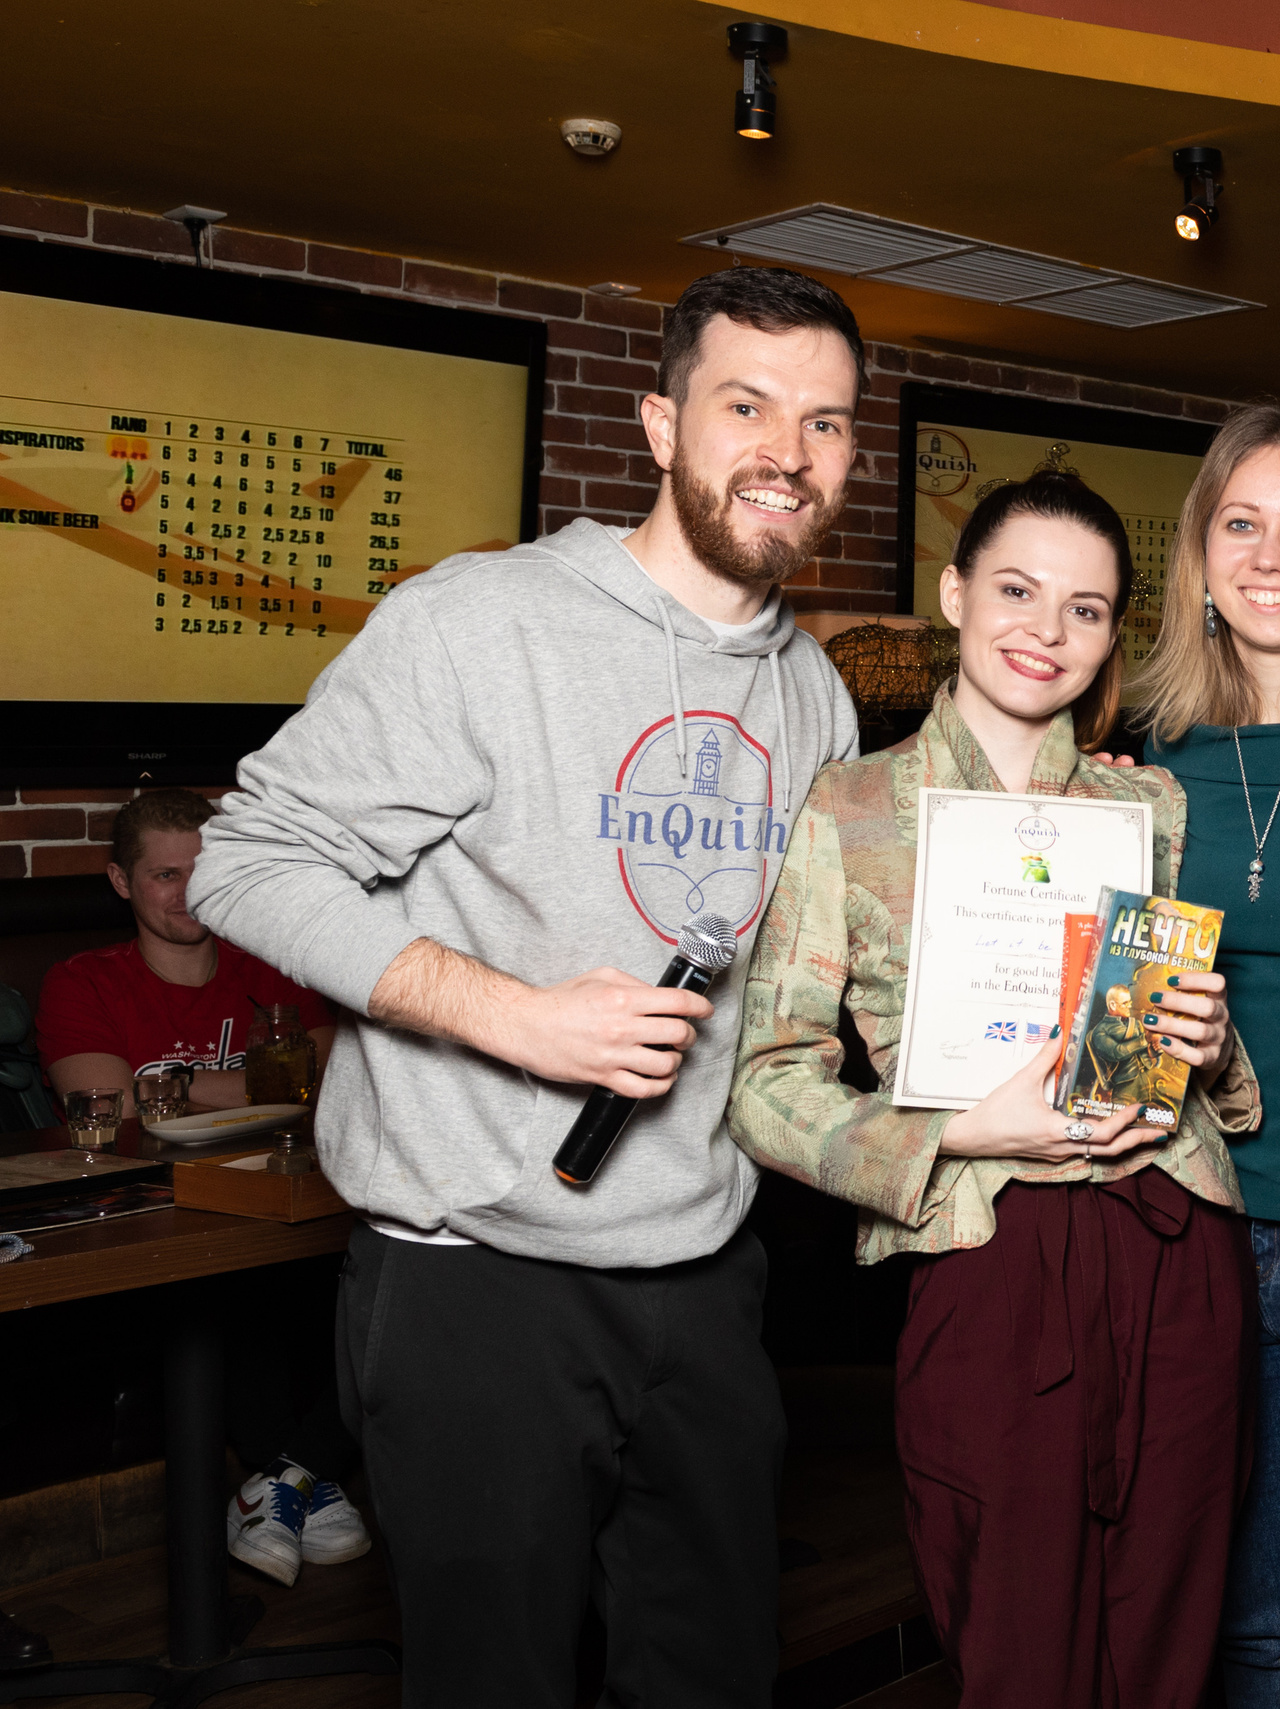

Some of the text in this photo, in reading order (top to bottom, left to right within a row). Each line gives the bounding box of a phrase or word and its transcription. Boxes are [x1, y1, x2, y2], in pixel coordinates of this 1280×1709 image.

[112, 416, 387, 457] RANG 1 2 3 4 5 6 7 TOTAL
[162, 445, 403, 482] 6 3 3 8 5 5 16 46
[918, 454, 979, 472] Quish
[161, 470, 402, 505] 5 4 4 6 3 2 13 37
[19, 510, 60, 526] SOME
[63, 513, 98, 529] BEER
[160, 494, 400, 528] 5 4 2 6 4 2,5 10 33,5
[159, 519, 399, 551] 5 4 2,5 2 2,5 2,5 8 26,5
[158, 543, 398, 573] 3 3,5 1 2 2 2 10 23,5
[157, 568, 397, 595] 5 3,5 3 3 4 1 3 22
[156, 592, 322, 614] 6 2 1,5 1 3,5 1 0
[155, 617, 327, 638] 3 2,5 2,5 2 2 2 -2
[128, 752, 167, 760] SHARP
[596, 793, 787, 859] EnQuish
[983, 881, 1087, 903] Fortune Certificate
[954, 904, 1065, 927] This certificate is pre
[1111, 906, 1215, 959] НЕЧТО
[995, 963, 1011, 974] for
[1012, 966, 1039, 977] good
[1109, 944, 1208, 971] ИЗ ГЛУБОКОЙ БЕЗДНЫ
[971, 979, 981, 989] in
[984, 979, 1000, 990] the
[1004, 980, 1049, 995] EnQuish
